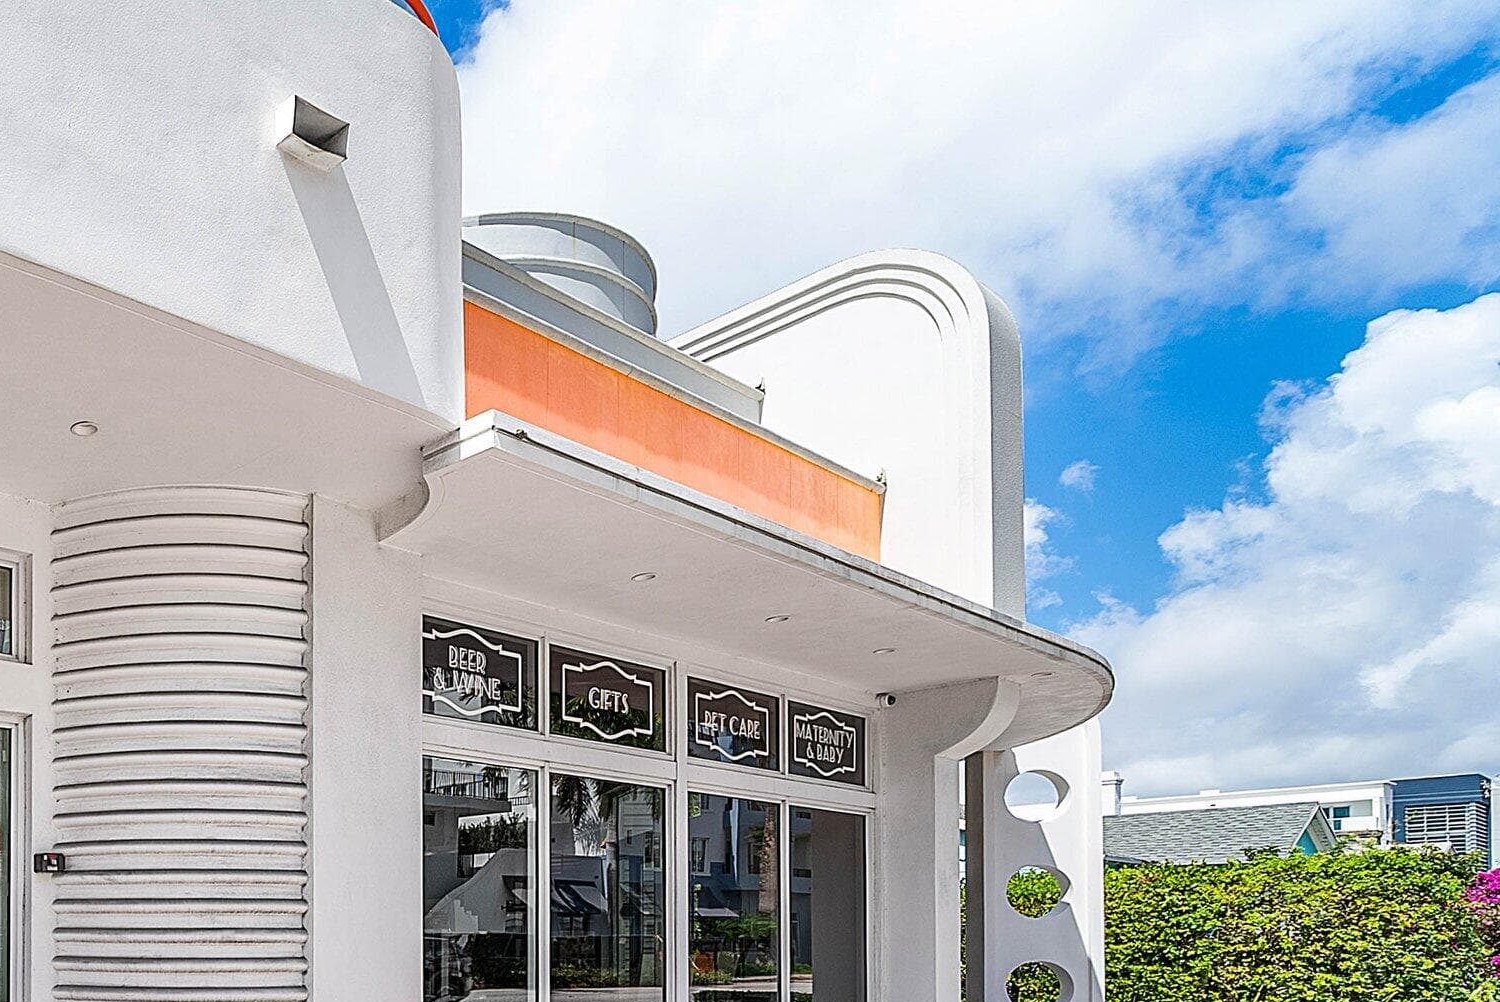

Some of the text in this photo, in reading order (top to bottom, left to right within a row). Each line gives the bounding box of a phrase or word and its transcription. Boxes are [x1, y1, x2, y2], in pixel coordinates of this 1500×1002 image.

[448, 645, 487, 675] BEER
[433, 667, 501, 700] & WINE
[588, 686, 629, 714] GIFTS
[704, 710, 761, 739] PET CARE
[796, 722, 854, 748] MATERNITY
[806, 742, 844, 764] & BABY
